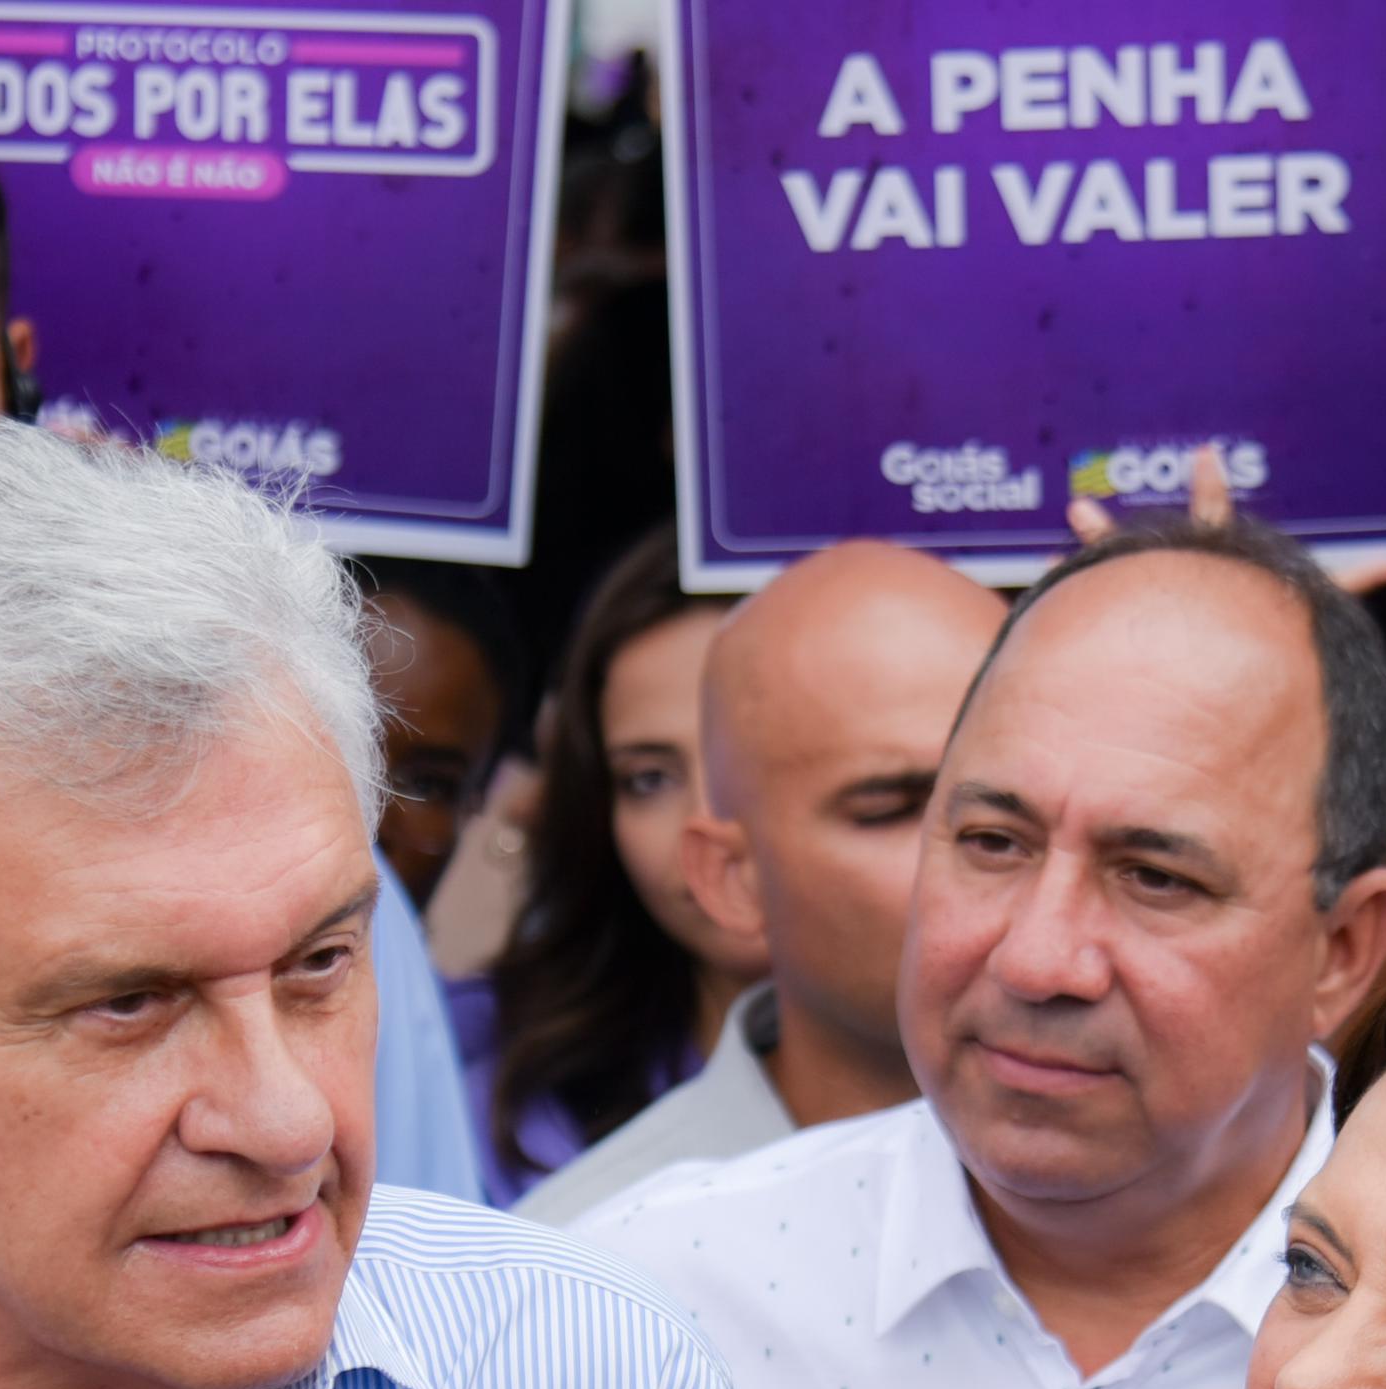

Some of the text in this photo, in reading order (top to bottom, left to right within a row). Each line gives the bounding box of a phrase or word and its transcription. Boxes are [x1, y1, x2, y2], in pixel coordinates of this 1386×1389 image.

[76, 25, 288, 65] PROTOCOLO
[133, 64, 270, 143] POR
[286, 70, 467, 148] ELAS
[817, 37, 1311, 137] A PENHA
[91, 150, 163, 188] NÃO
[193, 153, 267, 190] NÃO
[780, 151, 1351, 252] VAI VALER
[912, 466, 1042, 511] social
